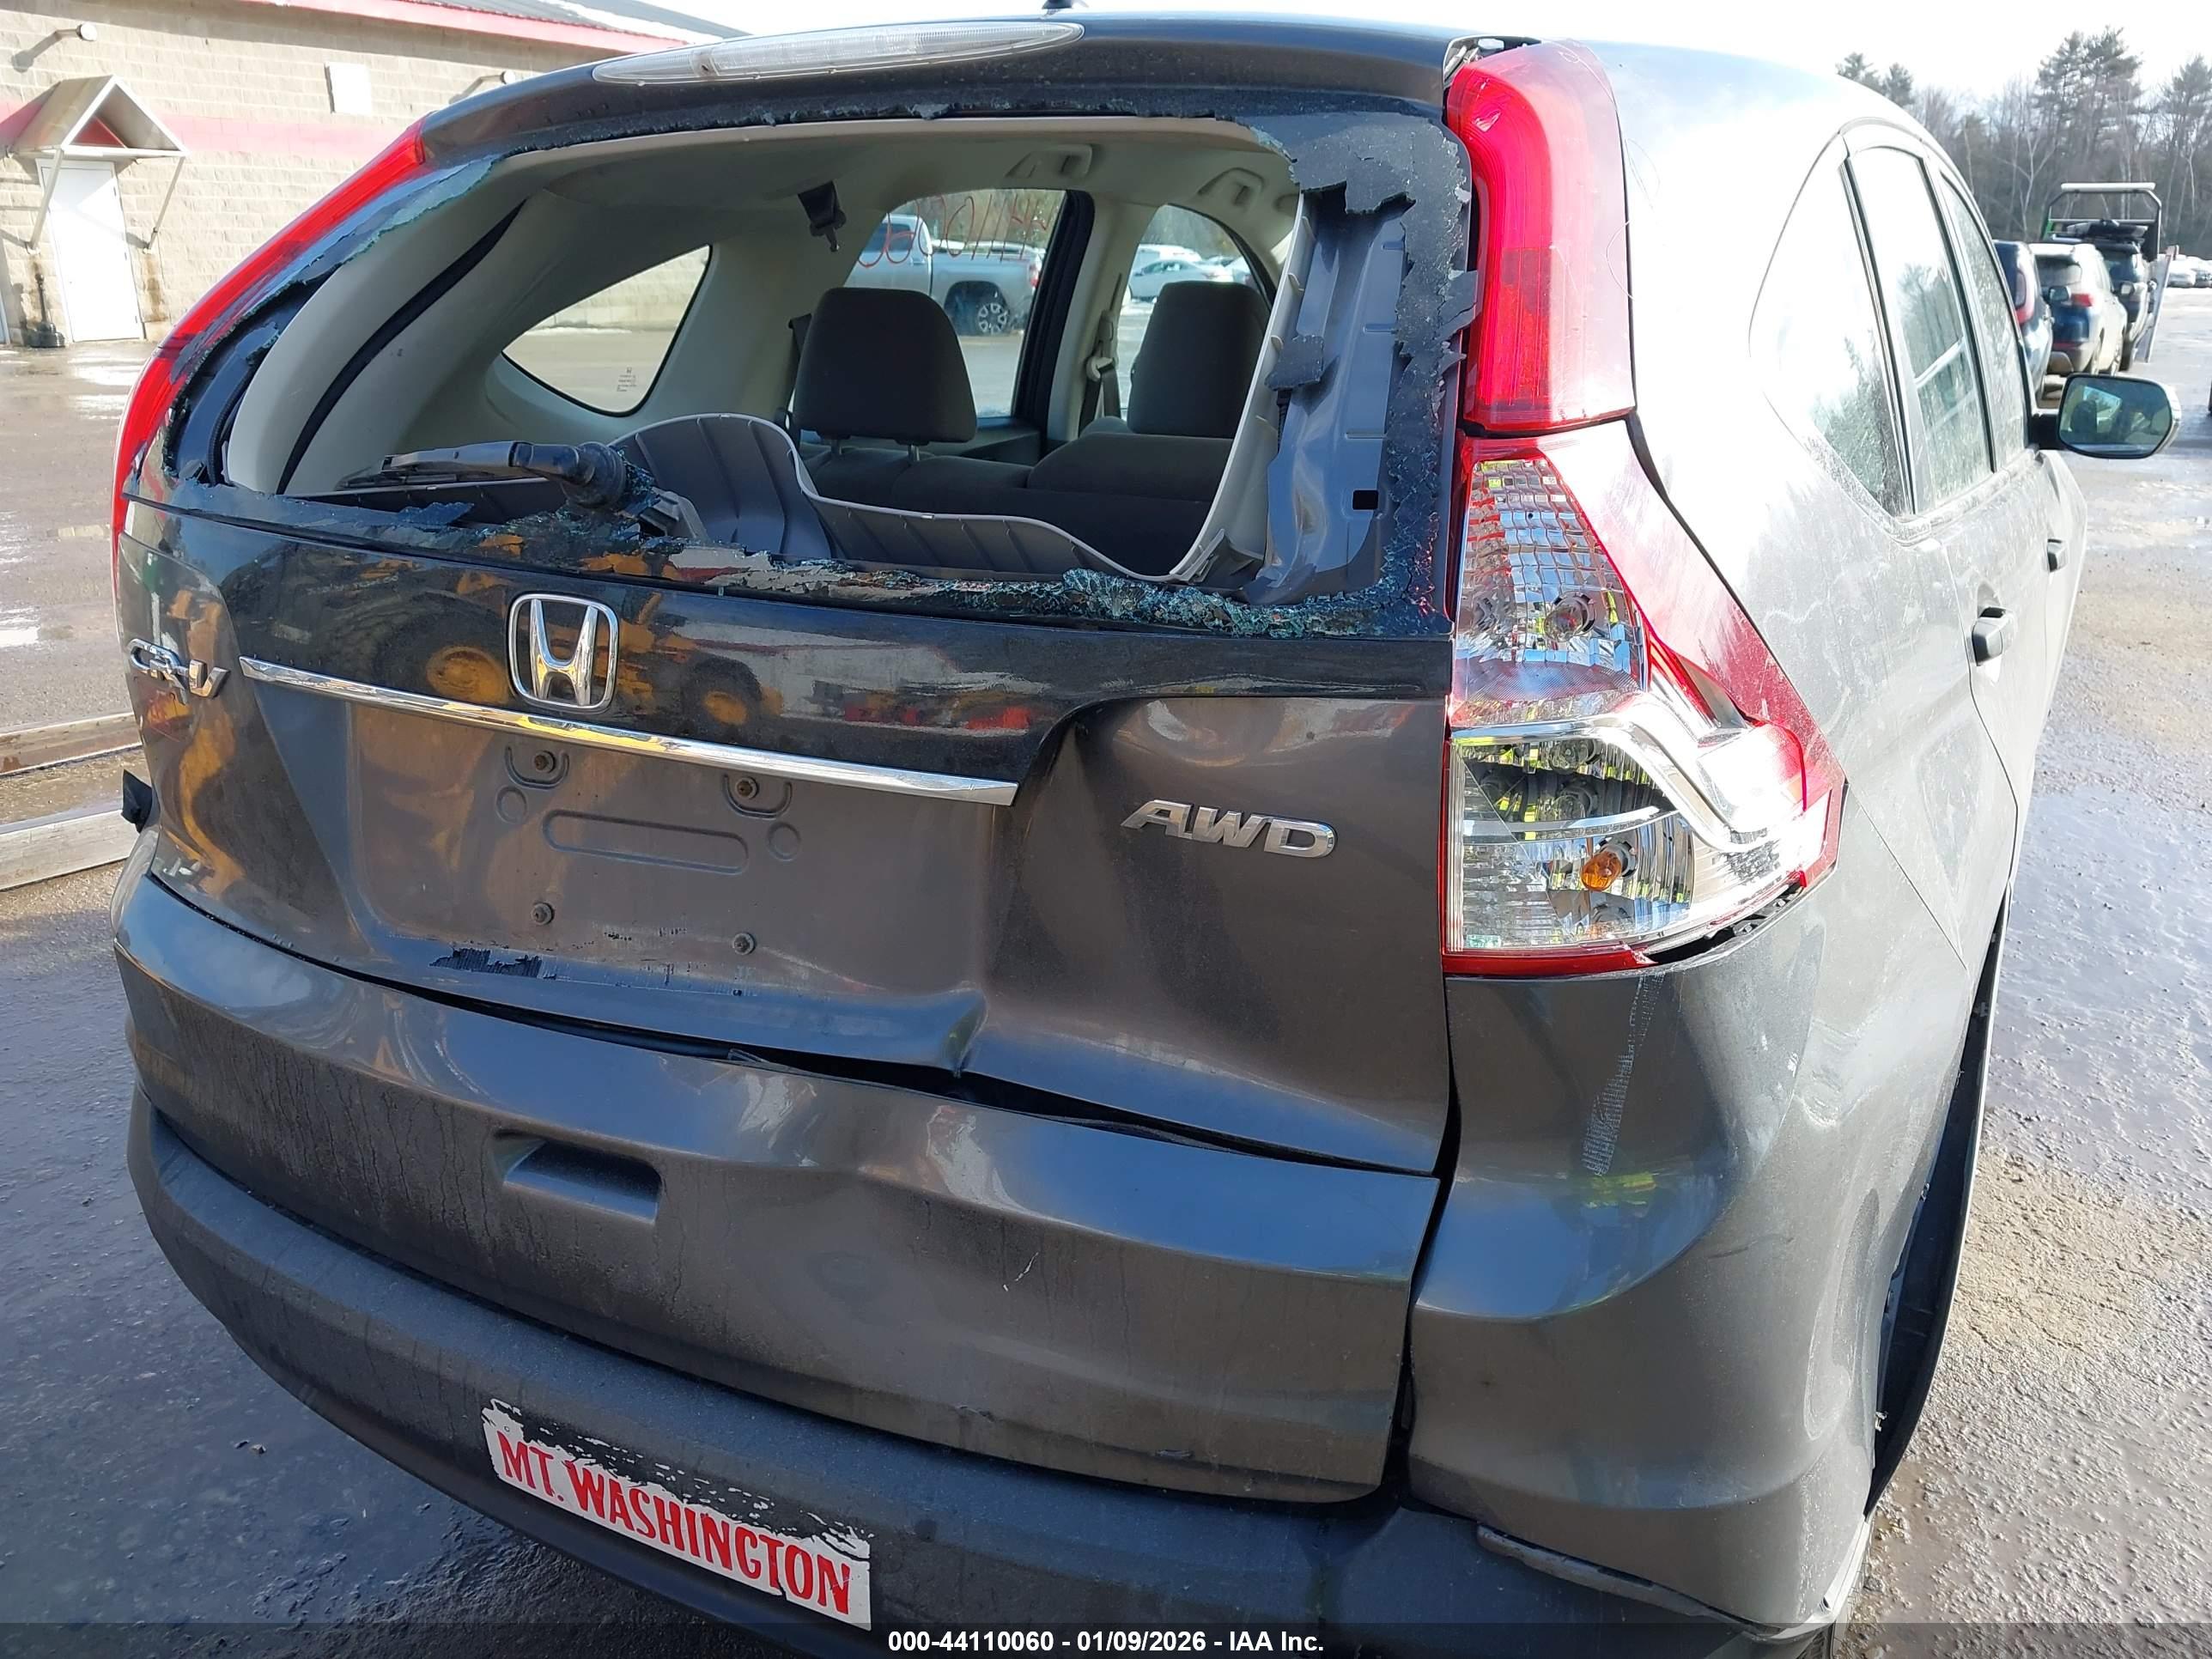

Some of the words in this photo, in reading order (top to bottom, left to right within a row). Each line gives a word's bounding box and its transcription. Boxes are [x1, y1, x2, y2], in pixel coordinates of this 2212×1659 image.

[1120, 799, 1338, 859] AWD
[497, 1431, 564, 1502] MT.
[564, 1460, 850, 1614] WASHINGTON
